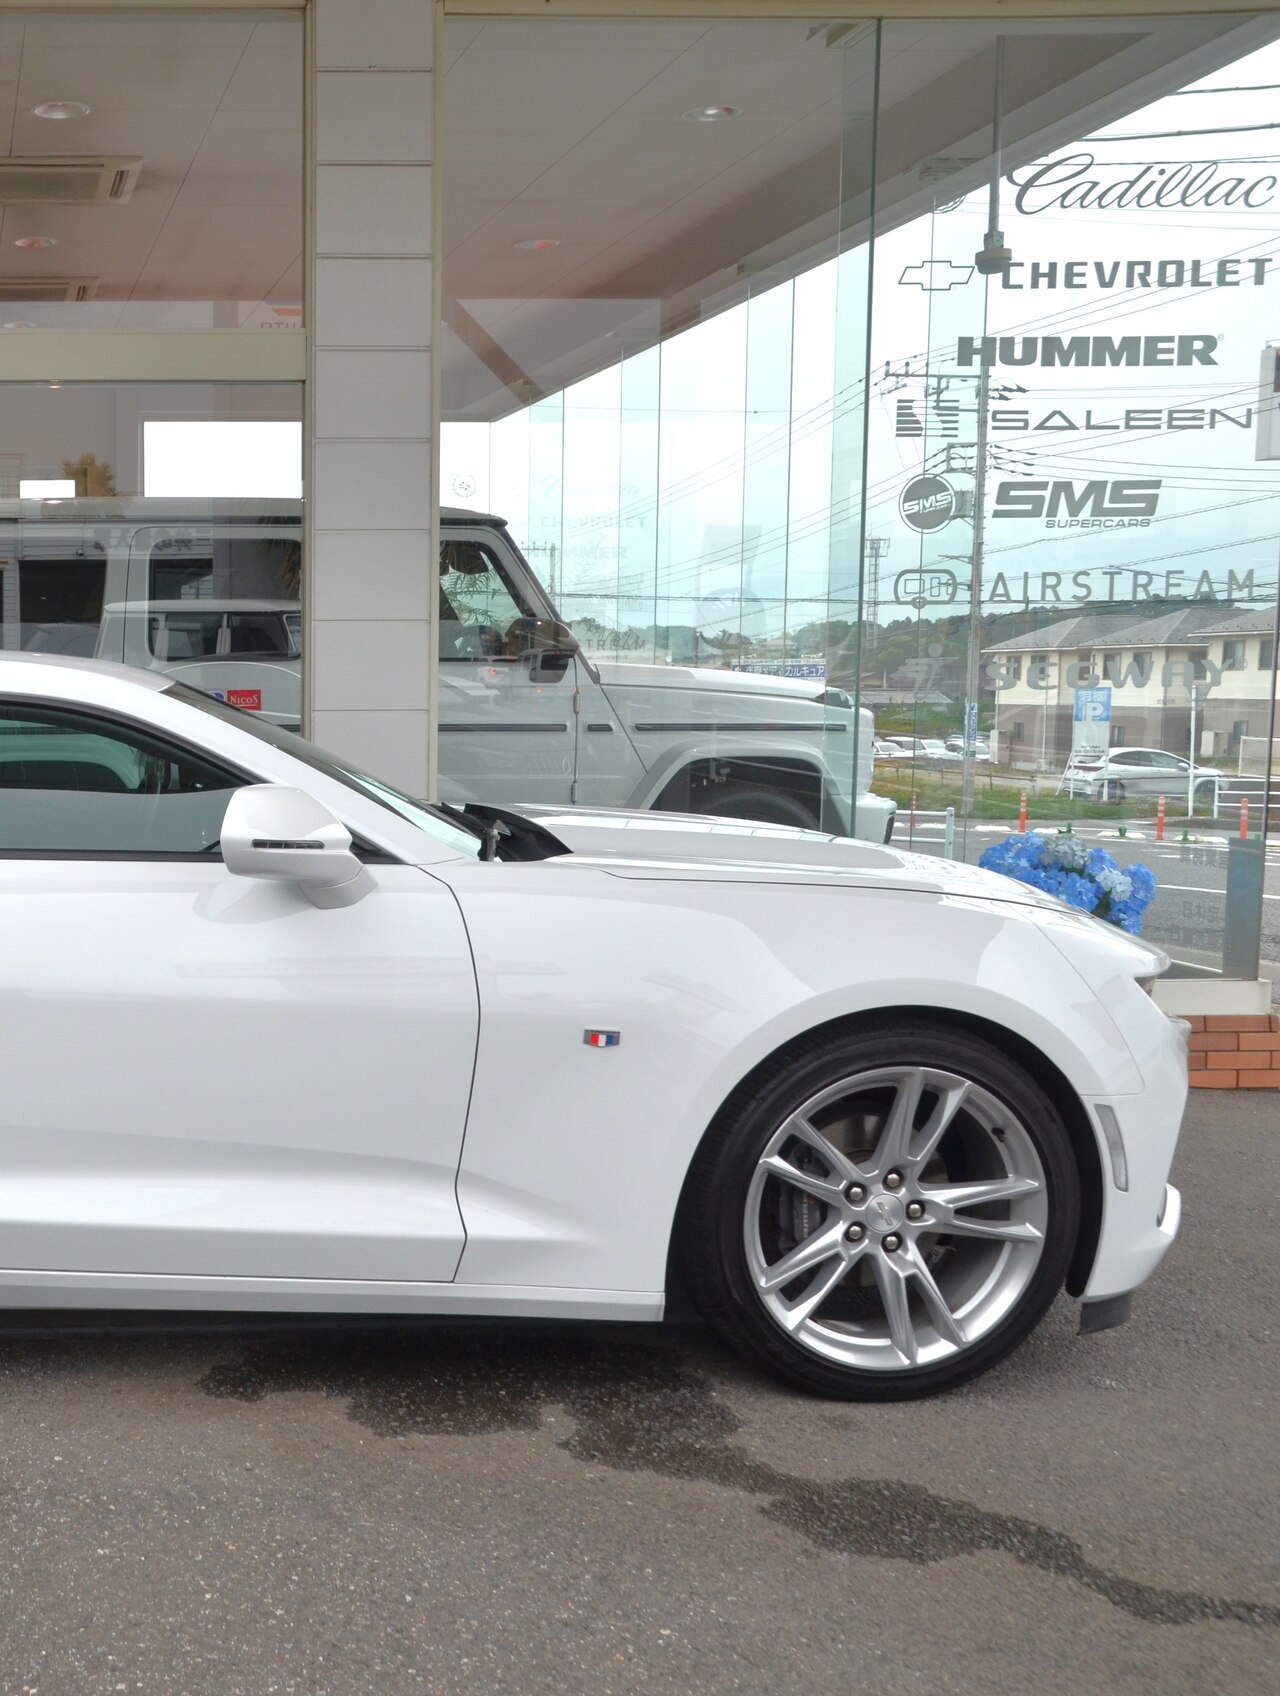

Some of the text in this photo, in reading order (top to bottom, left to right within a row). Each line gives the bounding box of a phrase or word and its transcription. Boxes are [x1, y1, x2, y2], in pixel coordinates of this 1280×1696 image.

[1006, 153, 1277, 215] Cadillac
[1001, 258, 1273, 289] CHEVROLET
[957, 335, 1219, 367] HUMMER
[991, 408, 1252, 431] SALEEN
[904, 491, 951, 515] SMS
[991, 479, 1163, 518] SMS
[1045, 518, 1151, 529] SUPERCARS
[988, 568, 1255, 602] AIRSTREAM
[984, 658, 1234, 691] SEGWAY
